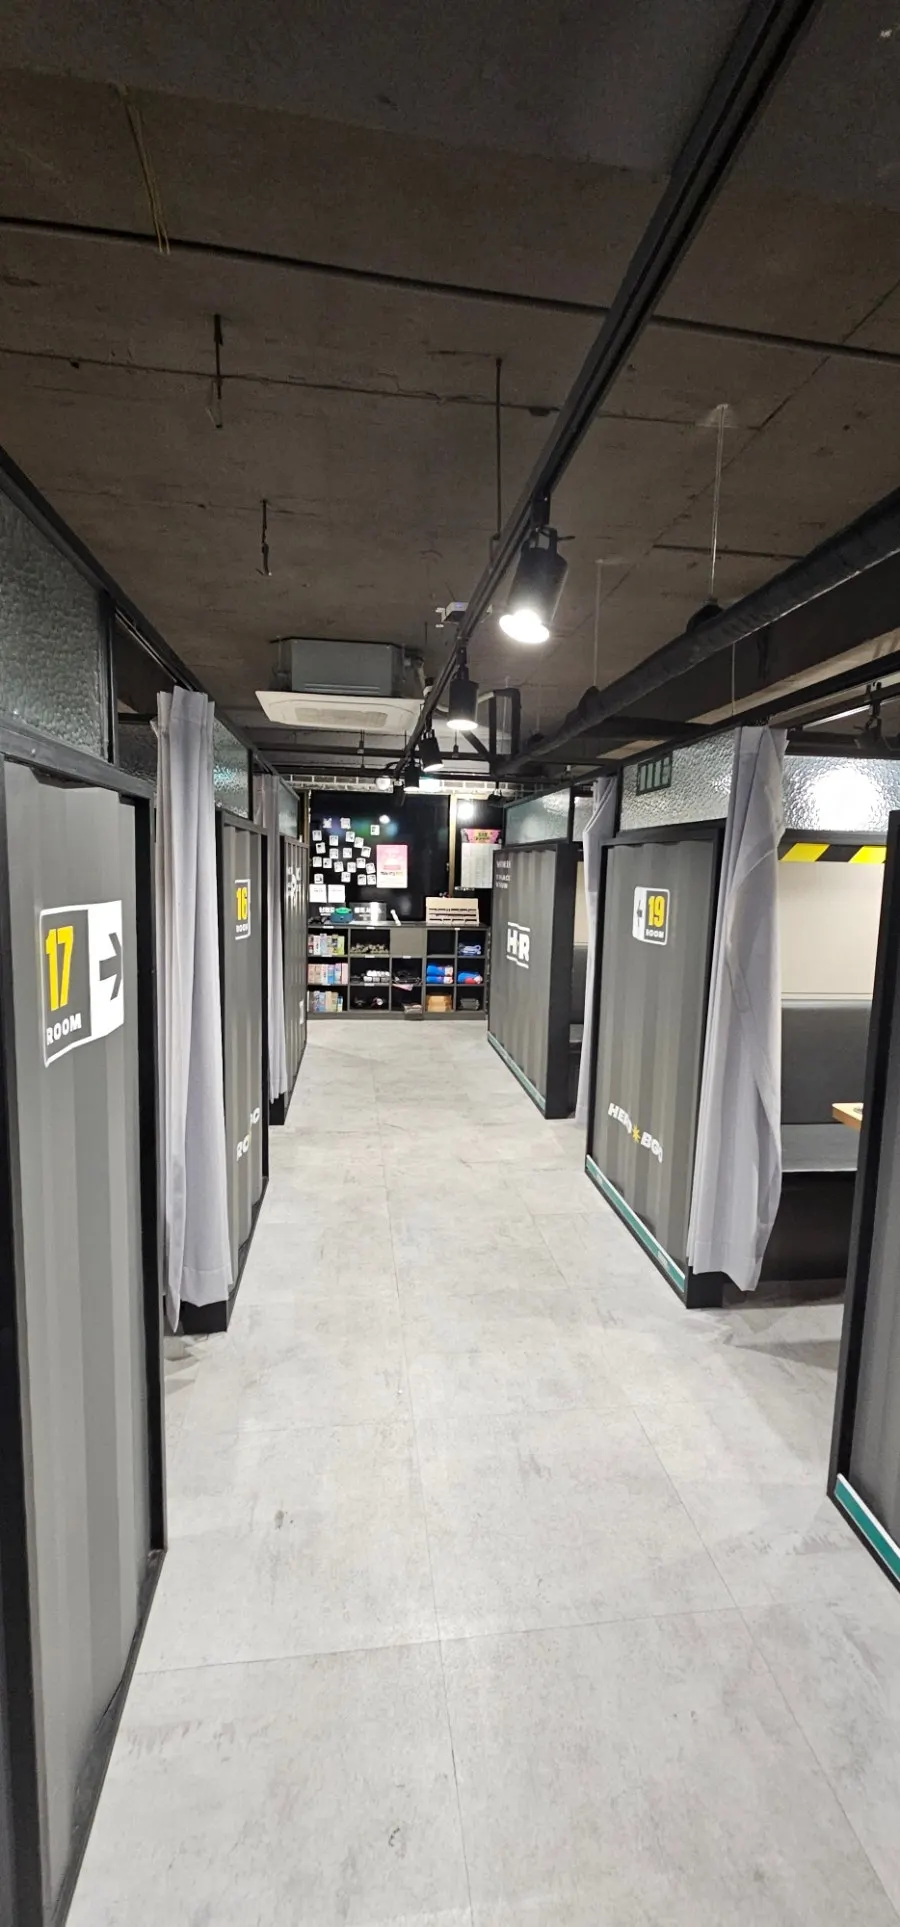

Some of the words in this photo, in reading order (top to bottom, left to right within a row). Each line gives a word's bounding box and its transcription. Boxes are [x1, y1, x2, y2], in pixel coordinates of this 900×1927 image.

[237, 887, 248, 920] 16
[648, 895, 665, 928] 19
[46, 925, 74, 1012] 17
[46, 1012, 82, 1046] ROOM
